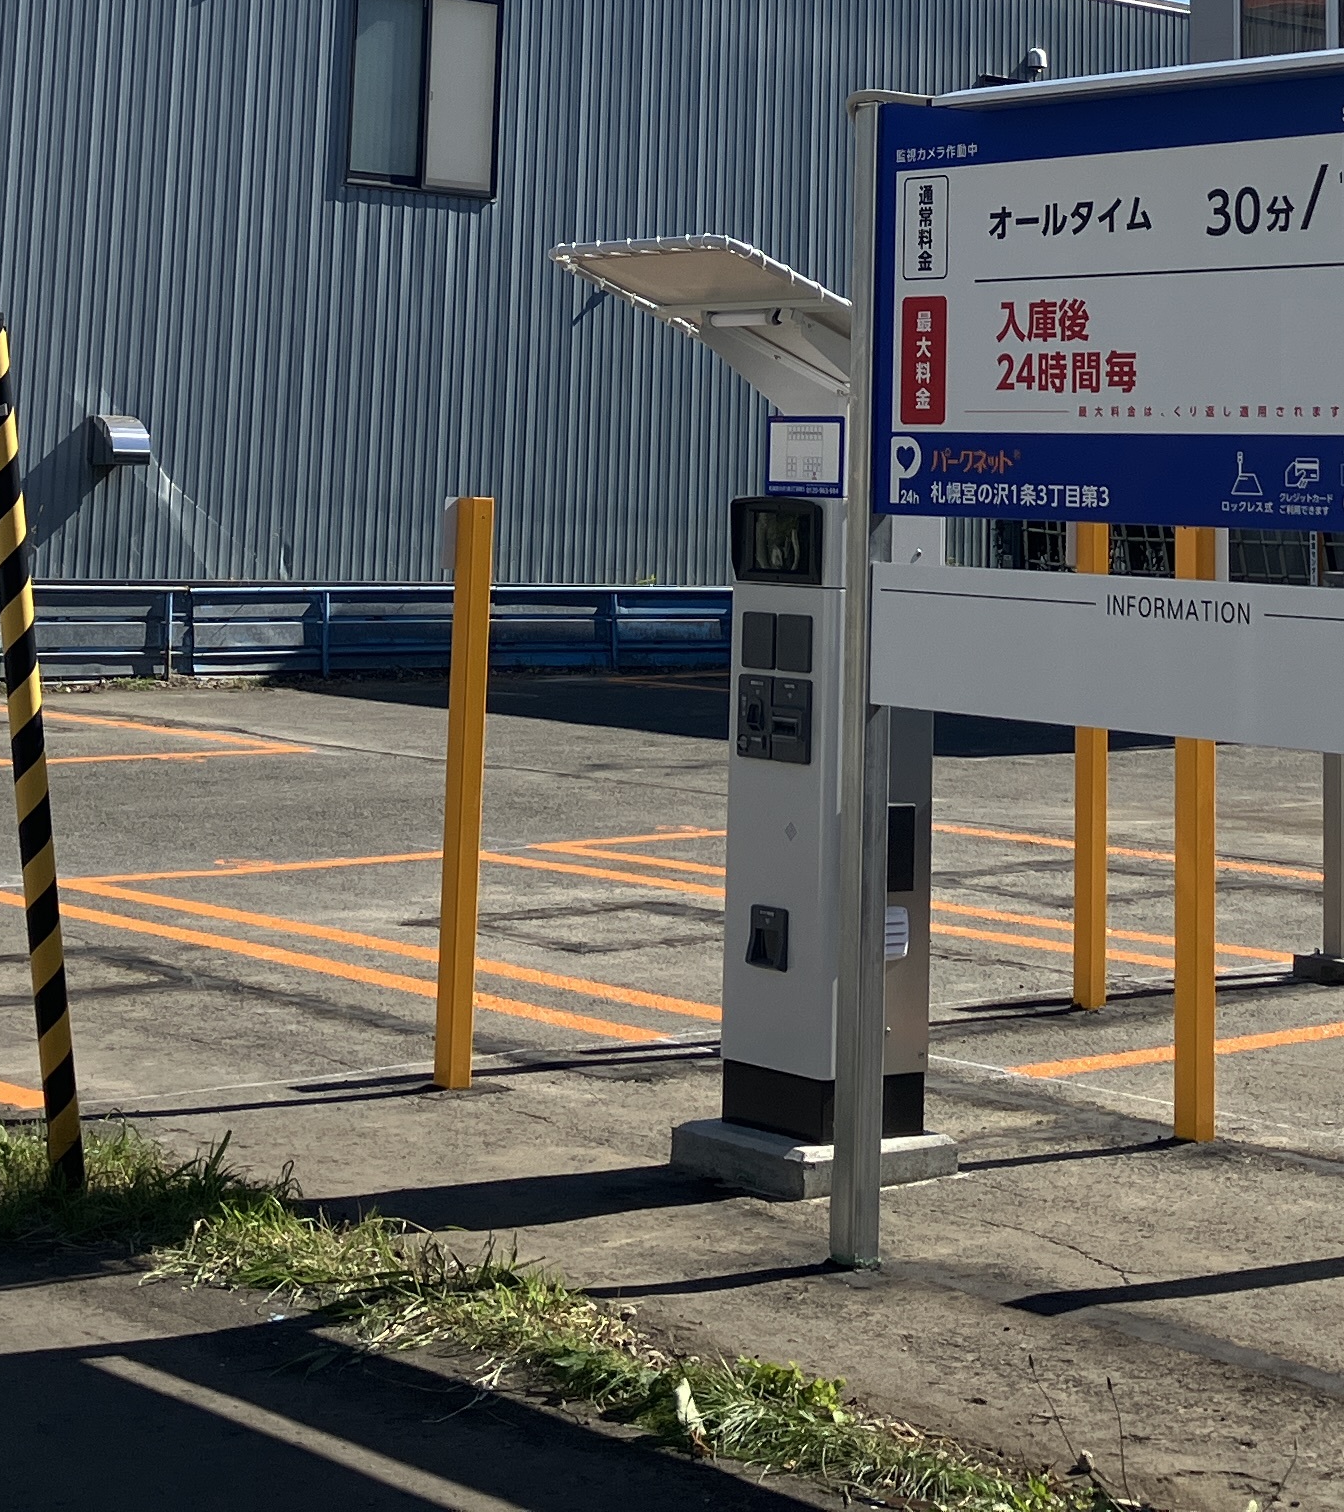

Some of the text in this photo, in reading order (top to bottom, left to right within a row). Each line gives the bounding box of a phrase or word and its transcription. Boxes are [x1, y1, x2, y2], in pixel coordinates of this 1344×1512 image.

[895, 143, 978, 163] 監視カメラ作動中
[917, 185, 934, 272] 通常料金
[988, 196, 1153, 240] オールタイム
[996, 298, 1090, 343] 入庫後
[915, 311, 932, 410] 最大料金
[995, 350, 1137, 394] 24時間毎
[900, 489, 920, 504] 24h
[930, 481, 1110, 508] 札幌宮の沢1条3丁目第3
[1221, 501, 1274, 513] ロックレス式
[1279, 493, 1334, 504] クレジットカード
[1106, 594, 1251, 625] INFORMATION
